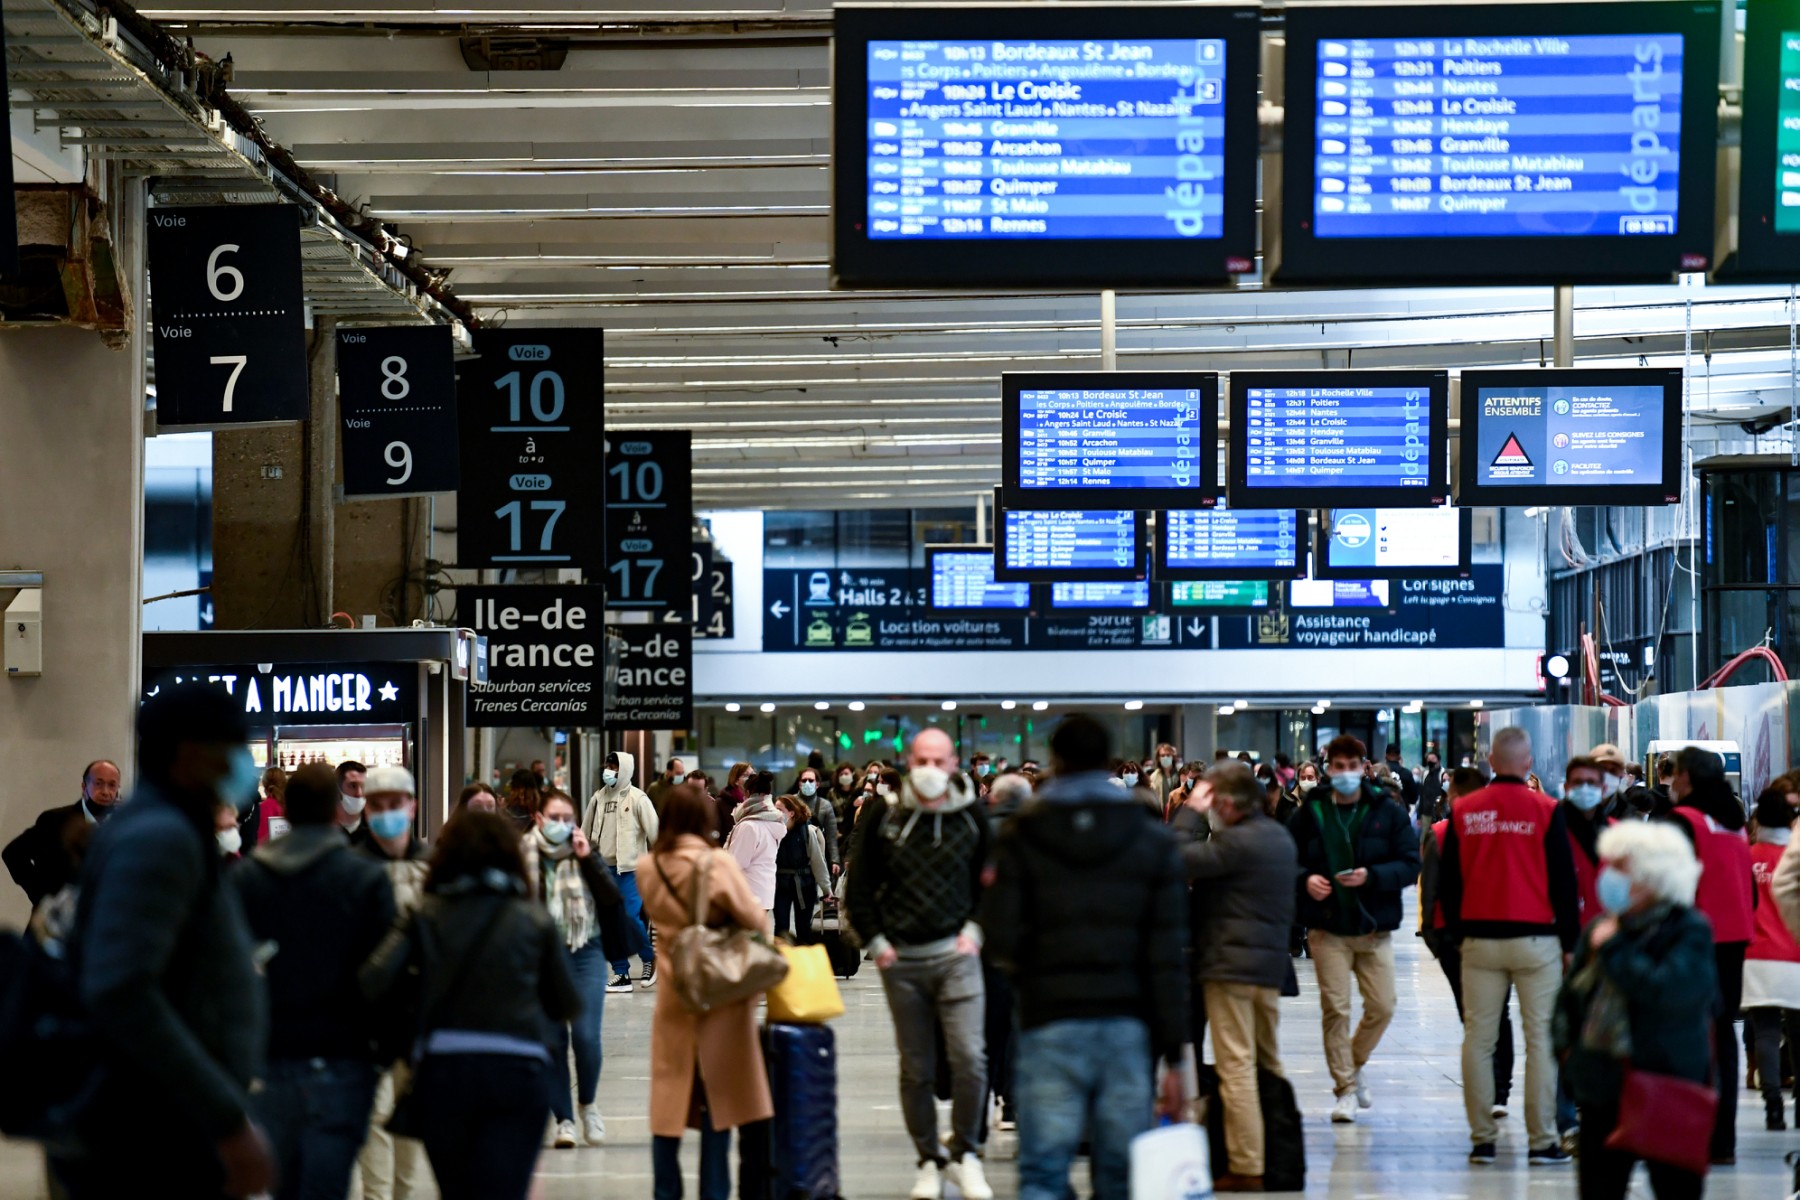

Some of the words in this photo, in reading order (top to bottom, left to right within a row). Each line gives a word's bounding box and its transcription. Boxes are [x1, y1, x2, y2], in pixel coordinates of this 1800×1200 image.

[991, 42, 1079, 61] Bordeaux
[1082, 42, 1104, 61] St
[1107, 42, 1153, 61] Jean
[1443, 40, 1463, 56] La
[1464, 39, 1532, 56] Rochelle
[1533, 38, 1570, 55] Ville
[917, 62, 961, 81] Corps
[971, 62, 1028, 79] Poitiers
[1443, 58, 1503, 75] Poitiers
[991, 81, 1016, 100] Le
[1017, 80, 1082, 100] Croisic
[1442, 78, 1499, 95] Nantes
[909, 101, 961, 120] Angers
[962, 101, 1003, 117] Saint
[1004, 101, 1042, 117] Laud
[1052, 101, 1107, 117] Nantes
[1116, 100, 1135, 117] St
[1441, 98, 1462, 115] Le
[1462, 97, 1517, 115] Croisic
[1621, 41, 1669, 213] départs
[990, 140, 1061, 156] Arcachon
[1440, 136, 1510, 154] Granville
[1441, 156, 1510, 172] Toulouse
[990, 178, 1058, 197] Quimper
[1440, 175, 1512, 192] Bordeaux
[1514, 175, 1532, 191] St
[1534, 175, 1572, 191] Jean
[1439, 194, 1507, 214] Quimper
[154, 215, 186, 227] Voie
[990, 216, 1046, 232] Rennes
[206, 243, 245, 302] 6
[160, 326, 192, 338] Voie
[342, 333, 366, 344] Voie
[515, 347, 544, 359] Voie
[210, 355, 247, 412] 7
[380, 356, 410, 400] 8
[494, 370, 565, 422] 10
[1083, 390, 1126, 399] Bordeaux
[1128, 390, 1139, 399] St
[1141, 391, 1163, 399] Jean
[1310, 389, 1320, 397] La
[1322, 389, 1354, 397] Rochelle
[1356, 389, 1373, 397] Ville
[1048, 401, 1070, 409] Corps
[1110, 401, 1153, 409] Angoulême
[1310, 399, 1339, 407] Poitiers
[1484, 397, 1542, 406] ATTENTIFS
[1083, 410, 1094, 418] Le
[1096, 410, 1128, 418] Croisic
[1485, 407, 1542, 416] ENSEMBLE
[346, 418, 371, 429] Voie
[1044, 420, 1070, 429] Angers
[1321, 418, 1347, 426] Croisic
[1082, 429, 1116, 437] Granville
[1310, 428, 1344, 436] Hendaye
[1400, 390, 1424, 475] départs
[525, 437, 536, 453] à
[624, 444, 648, 452] Voie
[1082, 448, 1116, 456] Toulouse
[1118, 448, 1153, 456] Matabiau
[1171, 402, 1195, 487] départs
[383, 441, 413, 485] 9
[519, 455, 529, 463] to
[1082, 458, 1116, 467] Quimper
[1310, 466, 1344, 475] Quimper
[515, 477, 545, 488] Voie
[609, 461, 663, 500] 10
[1082, 477, 1110, 485] Rennes
[494, 501, 566, 550] 17
[633, 512, 641, 524] à
[624, 541, 648, 550] Voie
[609, 559, 664, 598] 17
[840, 588, 886, 606] Halls
[889, 588, 901, 605] 2
[475, 598, 586, 630] Ile-de
[1296, 614, 1370, 628] Assistance
[880, 620, 939, 634] Location
[943, 621, 1000, 634] voitures
[1296, 631, 1360, 645] voyageur
[1364, 628, 1436, 645] handicapé
[490, 643, 594, 667] rance
[245, 676, 262, 713] A
[272, 673, 371, 713] MANGER
[469, 679, 535, 693] Suburban
[538, 679, 591, 693] services
[474, 699, 518, 712] Trenes
[520, 698, 587, 712] Cercanías
